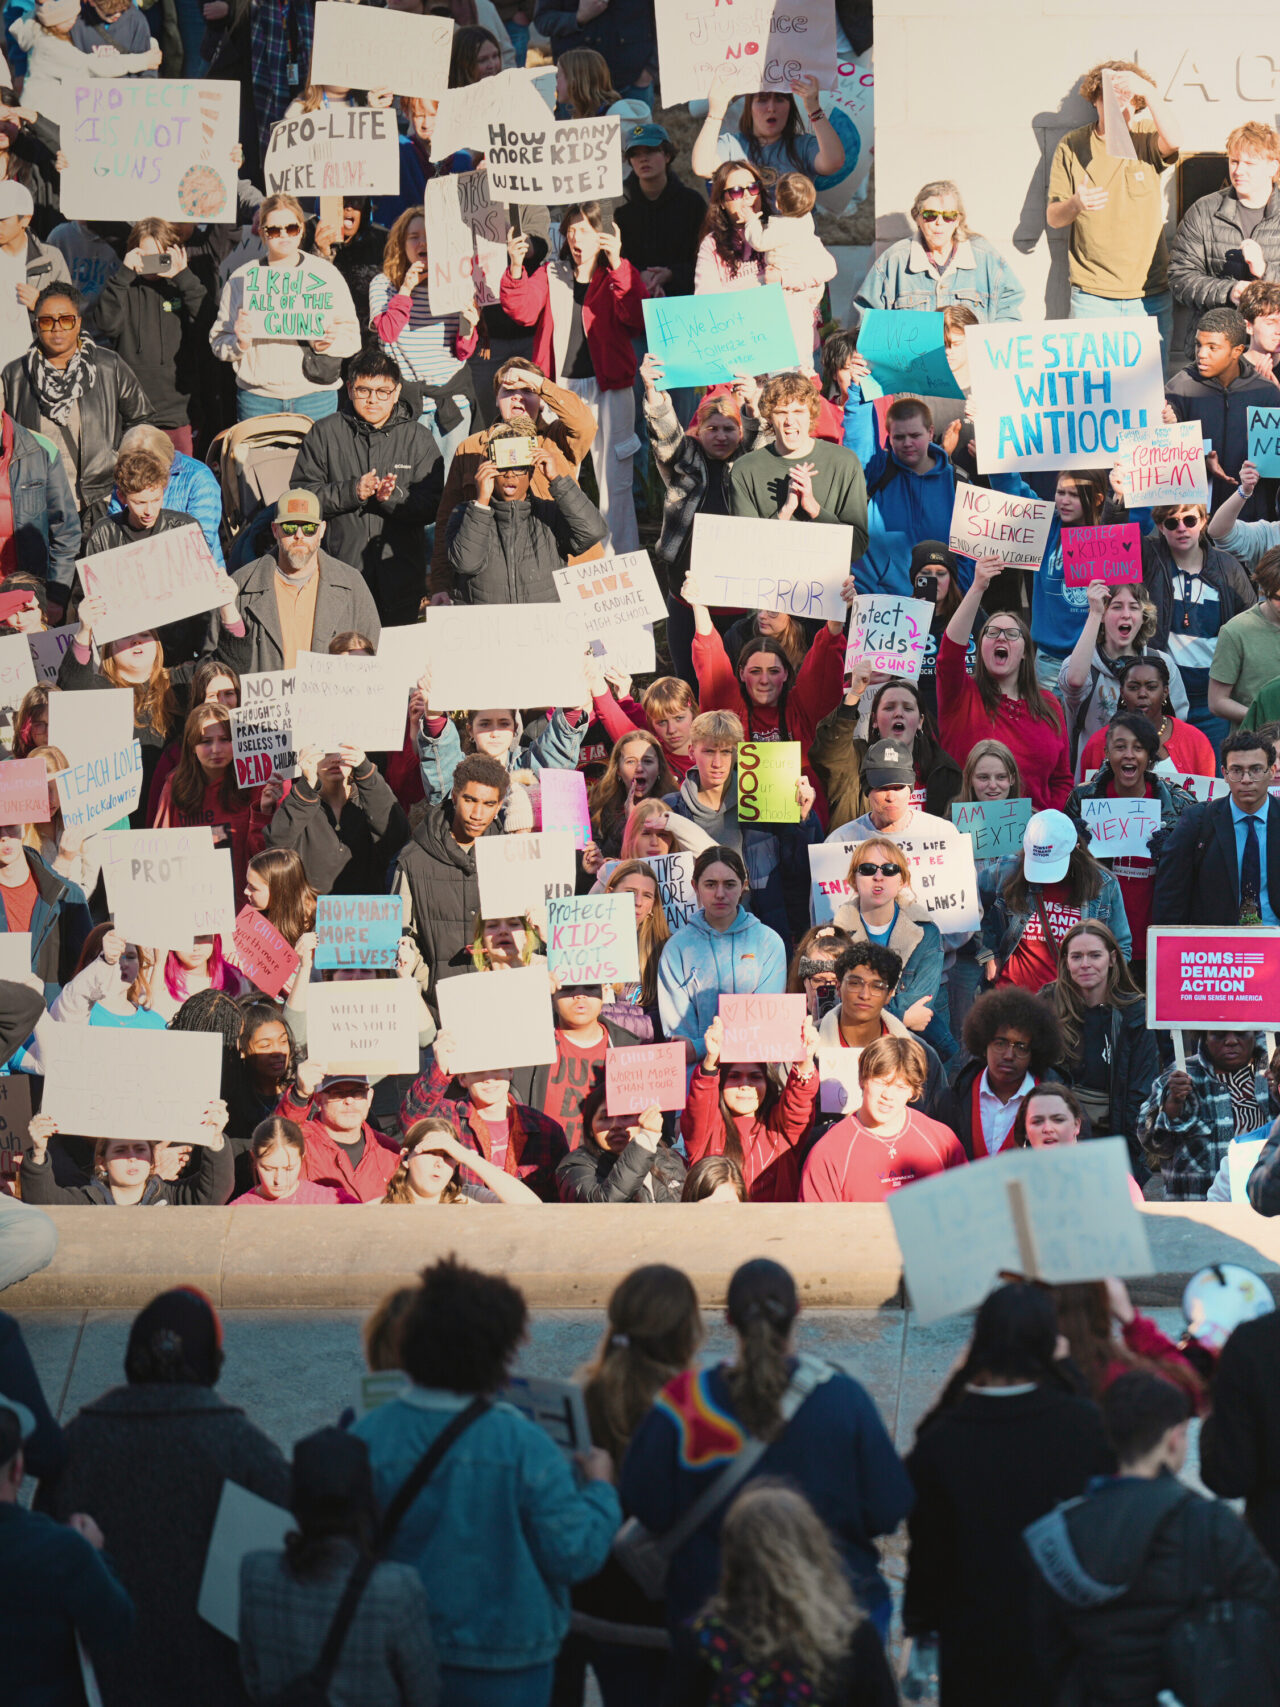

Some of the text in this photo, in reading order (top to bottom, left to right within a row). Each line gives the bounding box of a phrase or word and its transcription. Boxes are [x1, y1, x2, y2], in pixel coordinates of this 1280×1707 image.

[725, 42, 759, 60] NO
[75, 85, 193, 115] PROTECT
[133, 117, 191, 147] NOT
[271, 110, 387, 152] PRO-LIFE
[554, 123, 620, 145] MANY
[489, 141, 608, 165] MORE KIDS
[94, 154, 163, 184] GUNS
[493, 165, 608, 194] WILL DIE?
[246, 267, 260, 291] 1
[249, 292, 334, 311] ALL OF THE
[264, 312, 325, 336] GUNS
[985, 331, 1142, 370] WE STAND
[1014, 370, 1112, 408] WITH
[1132, 442, 1203, 468] remember
[1127, 463, 1196, 494] THEM
[963, 490, 1046, 520] NO MORE
[967, 515, 1035, 544] SILENCE
[1068, 523, 1129, 544] PROTECT
[950, 535, 1043, 564] END GUN VIOLENCE
[1079, 540, 1119, 559] KIDS
[560, 556, 638, 585] I WANT TO
[1070, 560, 1139, 580] NOT GUNS
[577, 571, 634, 600] LIVE
[713, 575, 825, 617] TERROR
[593, 590, 645, 613] GRADUATE
[851, 599, 904, 627] Protect
[584, 606, 651, 633] HIGH SCHOOL
[864, 629, 908, 654] Kids
[875, 656, 917, 673] GUNS
[246, 678, 274, 698] NO
[236, 701, 281, 725] THOUGHTS
[237, 719, 278, 738] PRAYERS
[238, 734, 287, 752] USELESS TO
[58, 756, 110, 800] TEACH
[113, 742, 142, 781] LOVE
[236, 752, 273, 785] DEAD
[63, 785, 137, 828] not lockdowns
[957, 801, 1019, 826] AM I
[1086, 800, 1147, 817] AM I
[504, 839, 541, 863] GUN
[923, 840, 946, 851] LIFE
[929, 855, 943, 866] BE
[922, 874, 936, 888] BY
[319, 900, 401, 922] HOW MANY
[548, 898, 616, 925] Protect
[926, 889, 965, 912] LAWS!
[241, 910, 283, 951] A CHILD
[319, 926, 369, 945] MORE
[551, 923, 618, 950] KIDS
[559, 947, 609, 966] NOT
[1180, 951, 1234, 964] MOMS
[552, 961, 619, 984] GUNS
[1180, 966, 1255, 978] DEMAND
[1180, 980, 1245, 992] ACTION
[330, 1004, 397, 1015] WHAT IF IT
[1236, 994, 1263, 1002] AMERICA
[745, 999, 789, 1022] KIDS
[331, 1021, 397, 1032] WAS YOUR
[725, 1026, 760, 1045] NOT
[349, 1038, 380, 1049] KID?
[608, 1047, 673, 1066] A CHILD IS
[610, 1066, 679, 1083] WORTH MORE
[616, 1083, 645, 1095] THAN
